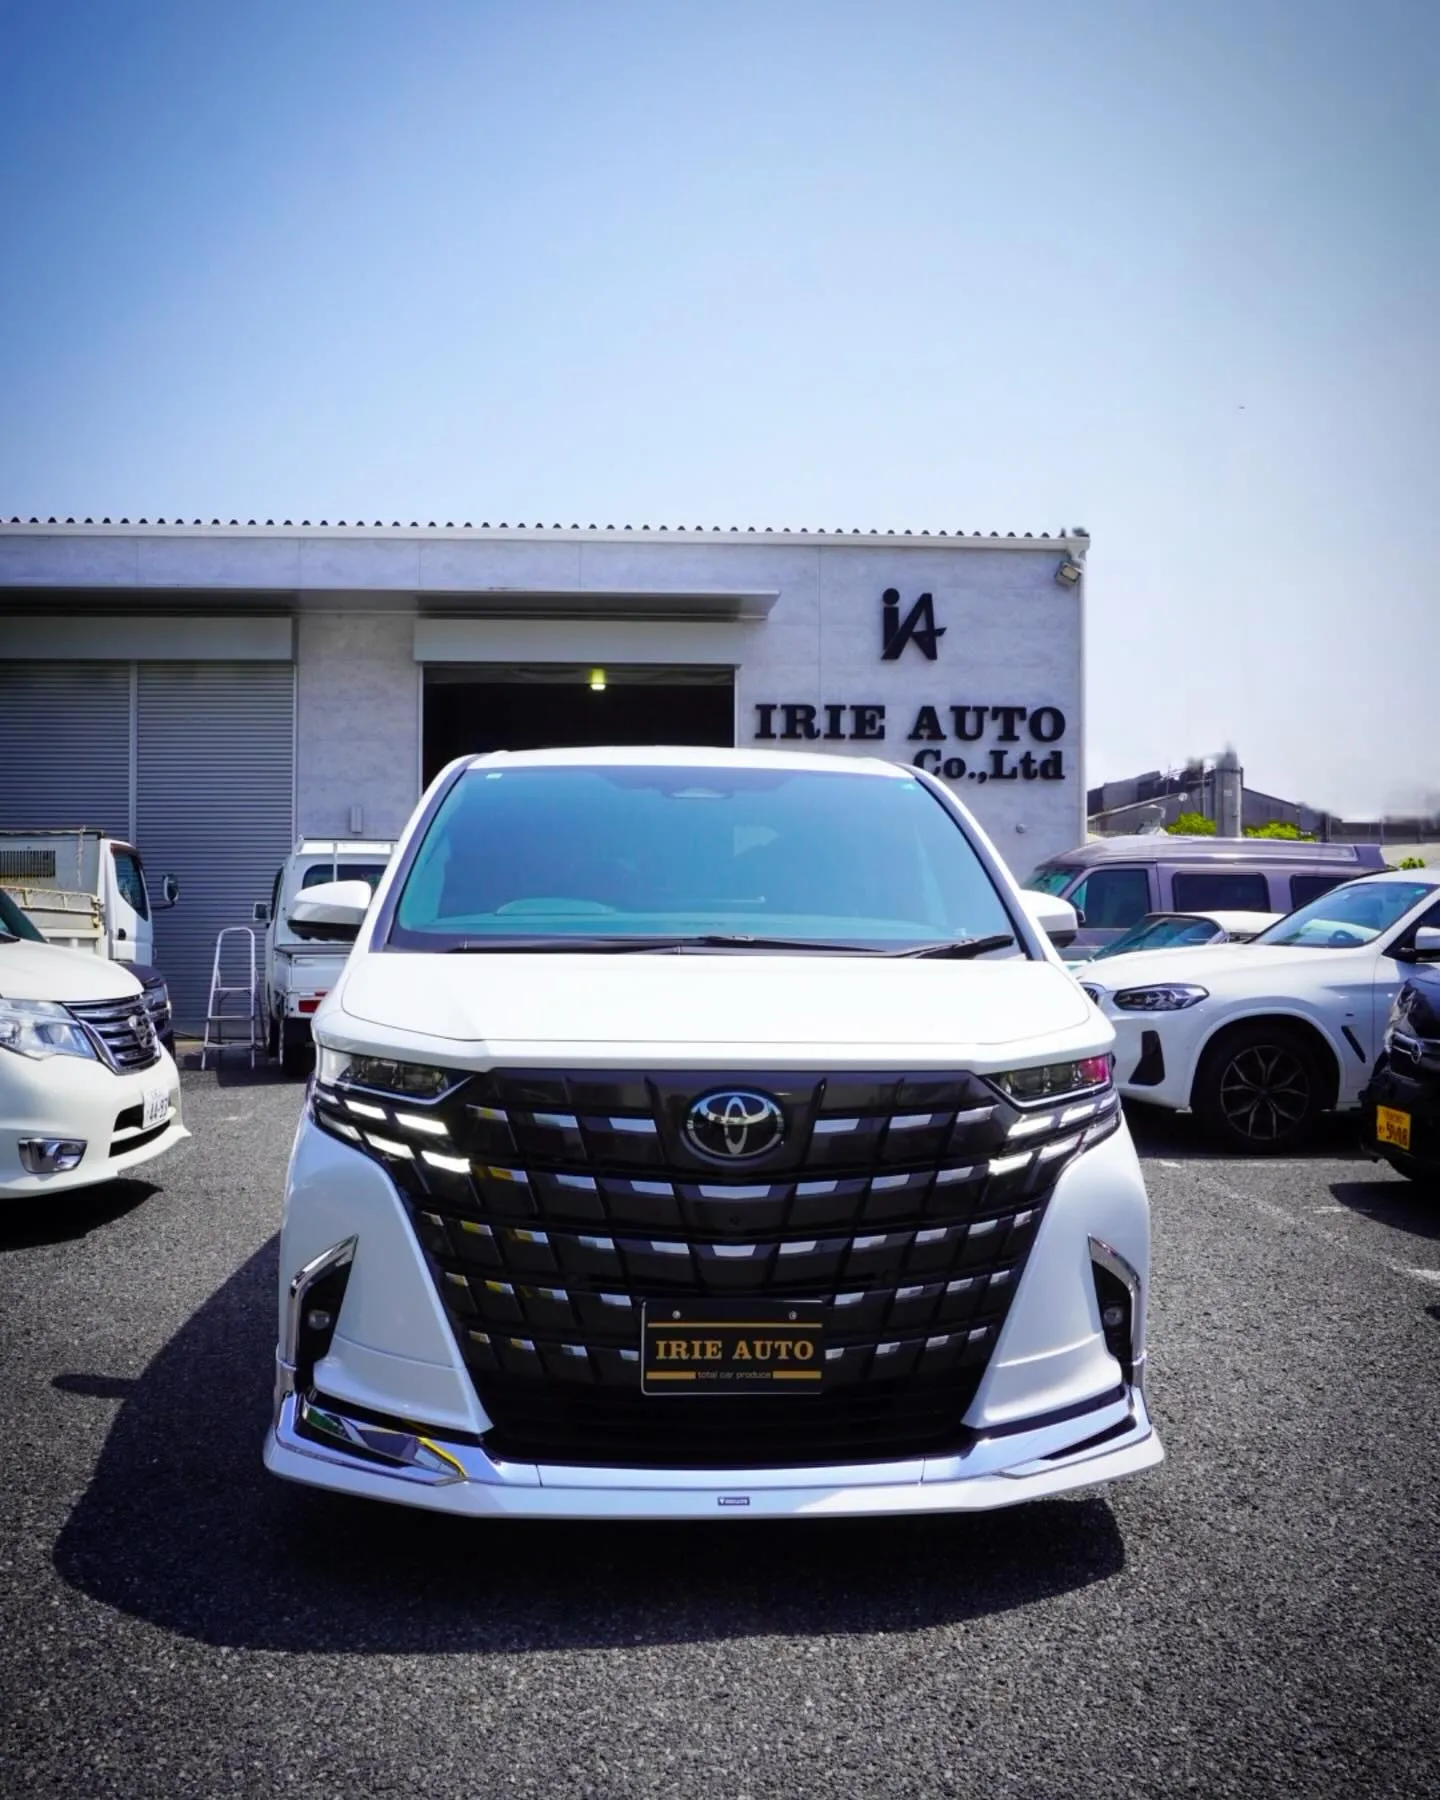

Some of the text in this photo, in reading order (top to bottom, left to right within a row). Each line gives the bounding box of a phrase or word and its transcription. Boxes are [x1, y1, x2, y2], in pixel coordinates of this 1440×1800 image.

[755, 704, 1066, 742] IRIE AUTO
[913, 749, 1065, 783] Co.,Ltd
[656, 1340, 814, 1360] IRIE AUTO
[698, 1370, 718, 1379] total
